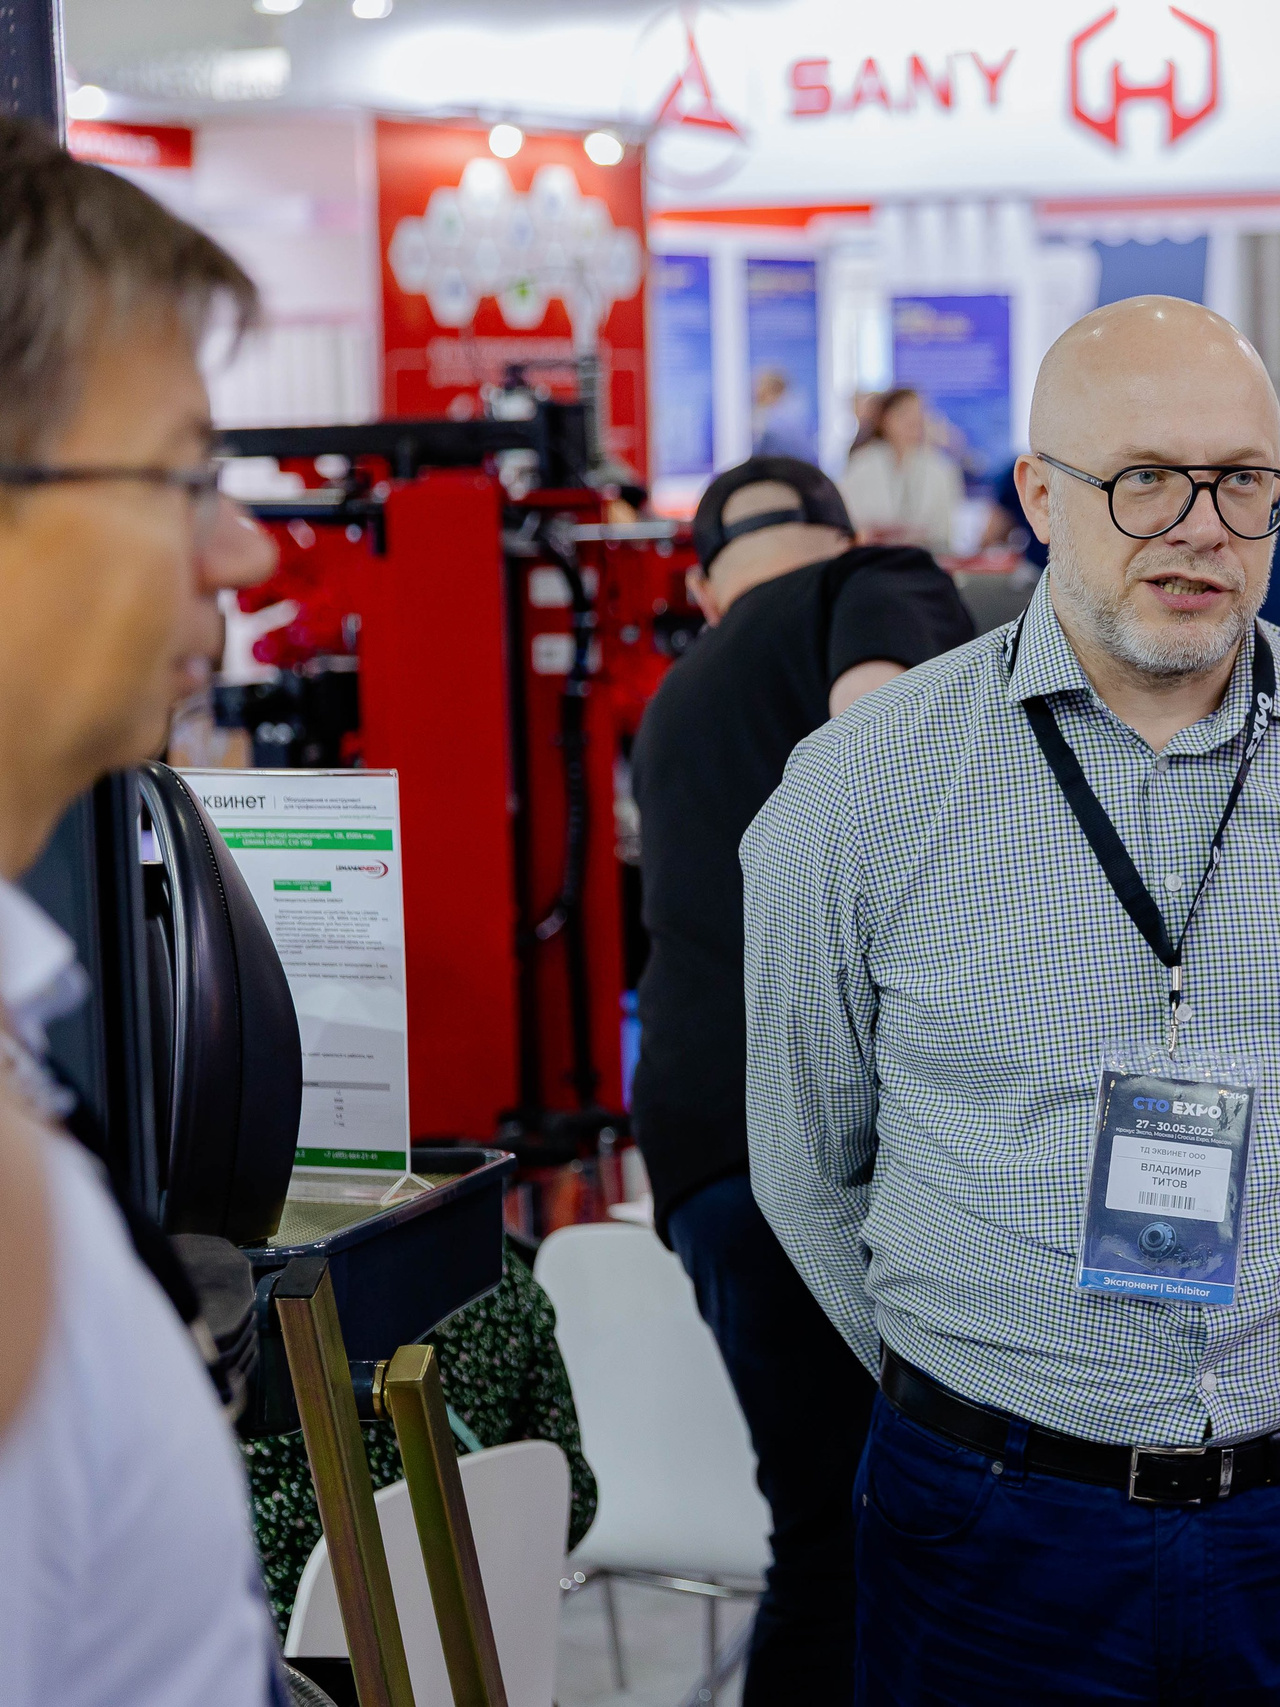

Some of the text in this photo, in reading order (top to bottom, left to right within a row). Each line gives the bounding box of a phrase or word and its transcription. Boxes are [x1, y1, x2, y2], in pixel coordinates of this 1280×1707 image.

[792, 49, 1017, 115] SANY
[1246, 691, 1274, 761] EXPO
[1172, 1101, 1221, 1119] EXPO
[1115, 1126, 1135, 1135] Крокус
[1153, 1131, 1175, 1139] Москва
[1177, 1134, 1196, 1142] Crocus
[1210, 1138, 1233, 1146] Moscow
[1140, 1146, 1206, 1160] ТД ЭКВИНЕТ ООО
[1140, 1162, 1202, 1178] ВЛАДИМИР
[1152, 1176, 1188, 1189] ТИТОВ
[1103, 1276, 1159, 1291] Экспонент
[1165, 1284, 1211, 1297] Exhibitor
